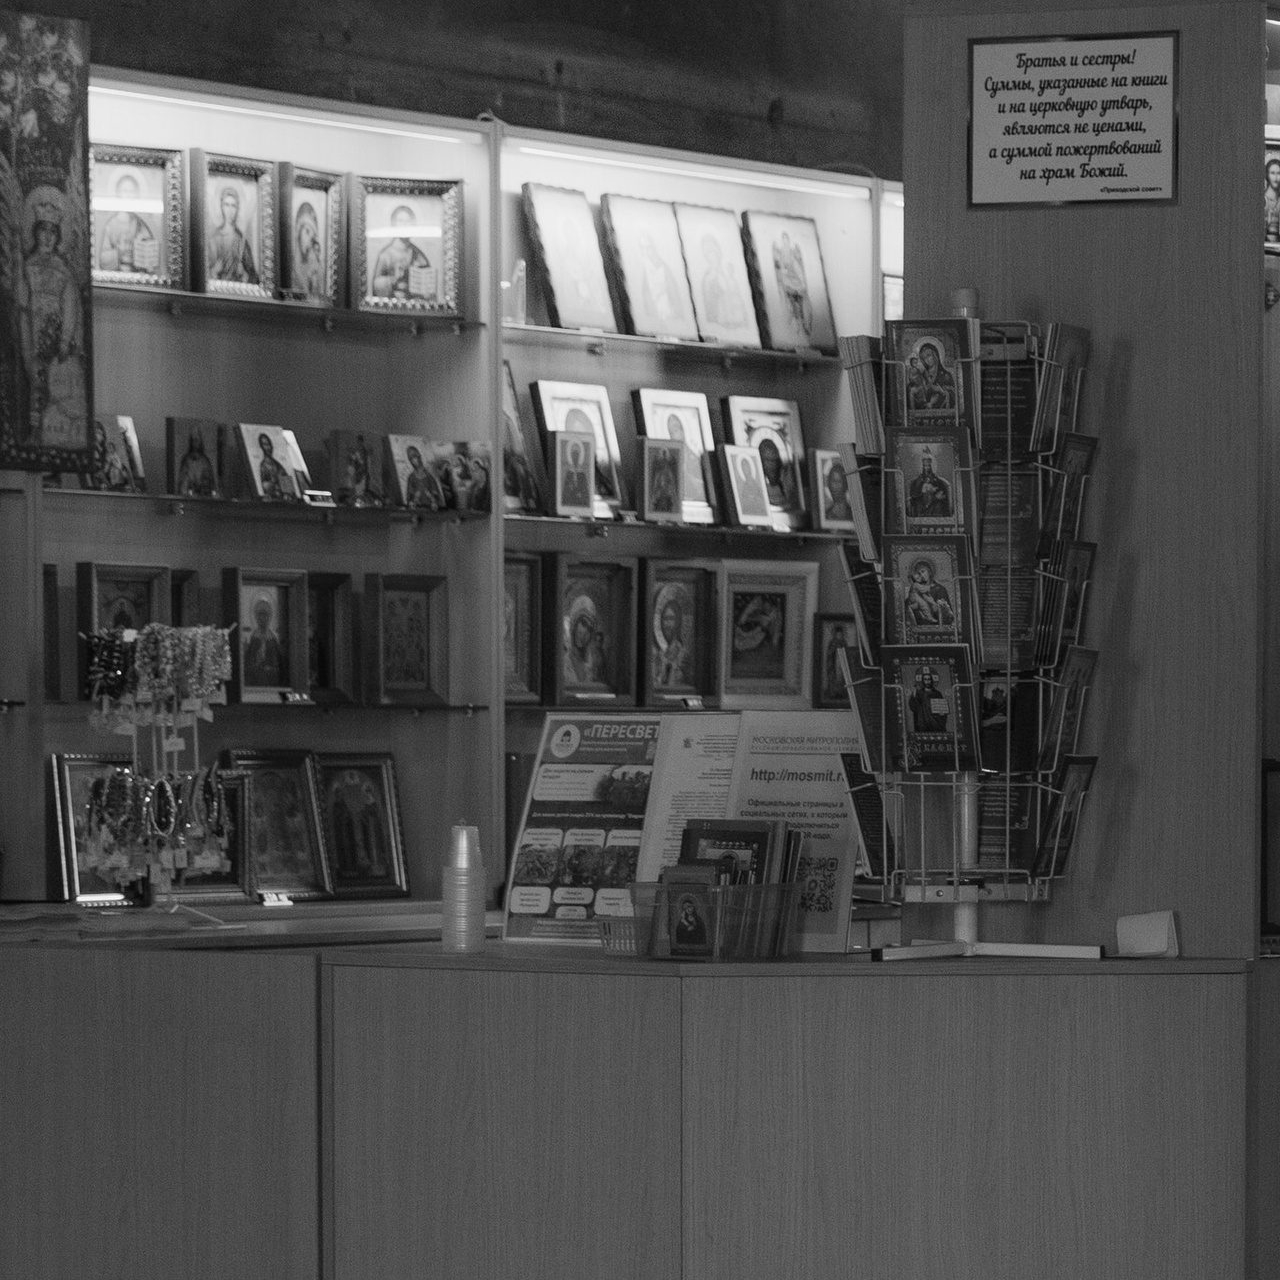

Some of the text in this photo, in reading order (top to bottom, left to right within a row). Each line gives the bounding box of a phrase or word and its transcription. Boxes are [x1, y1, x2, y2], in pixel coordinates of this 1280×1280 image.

[1015, 49, 1137, 74] Братья и сестры!
[984, 75, 1169, 98] Суммы, указанные на книги
[998, 95, 1153, 119] и на церковную утварь,
[1002, 121, 1147, 137] являются не ценами,
[989, 139, 1162, 165] а суммой пожертвований
[1020, 163, 1128, 186] на храм Божий.
